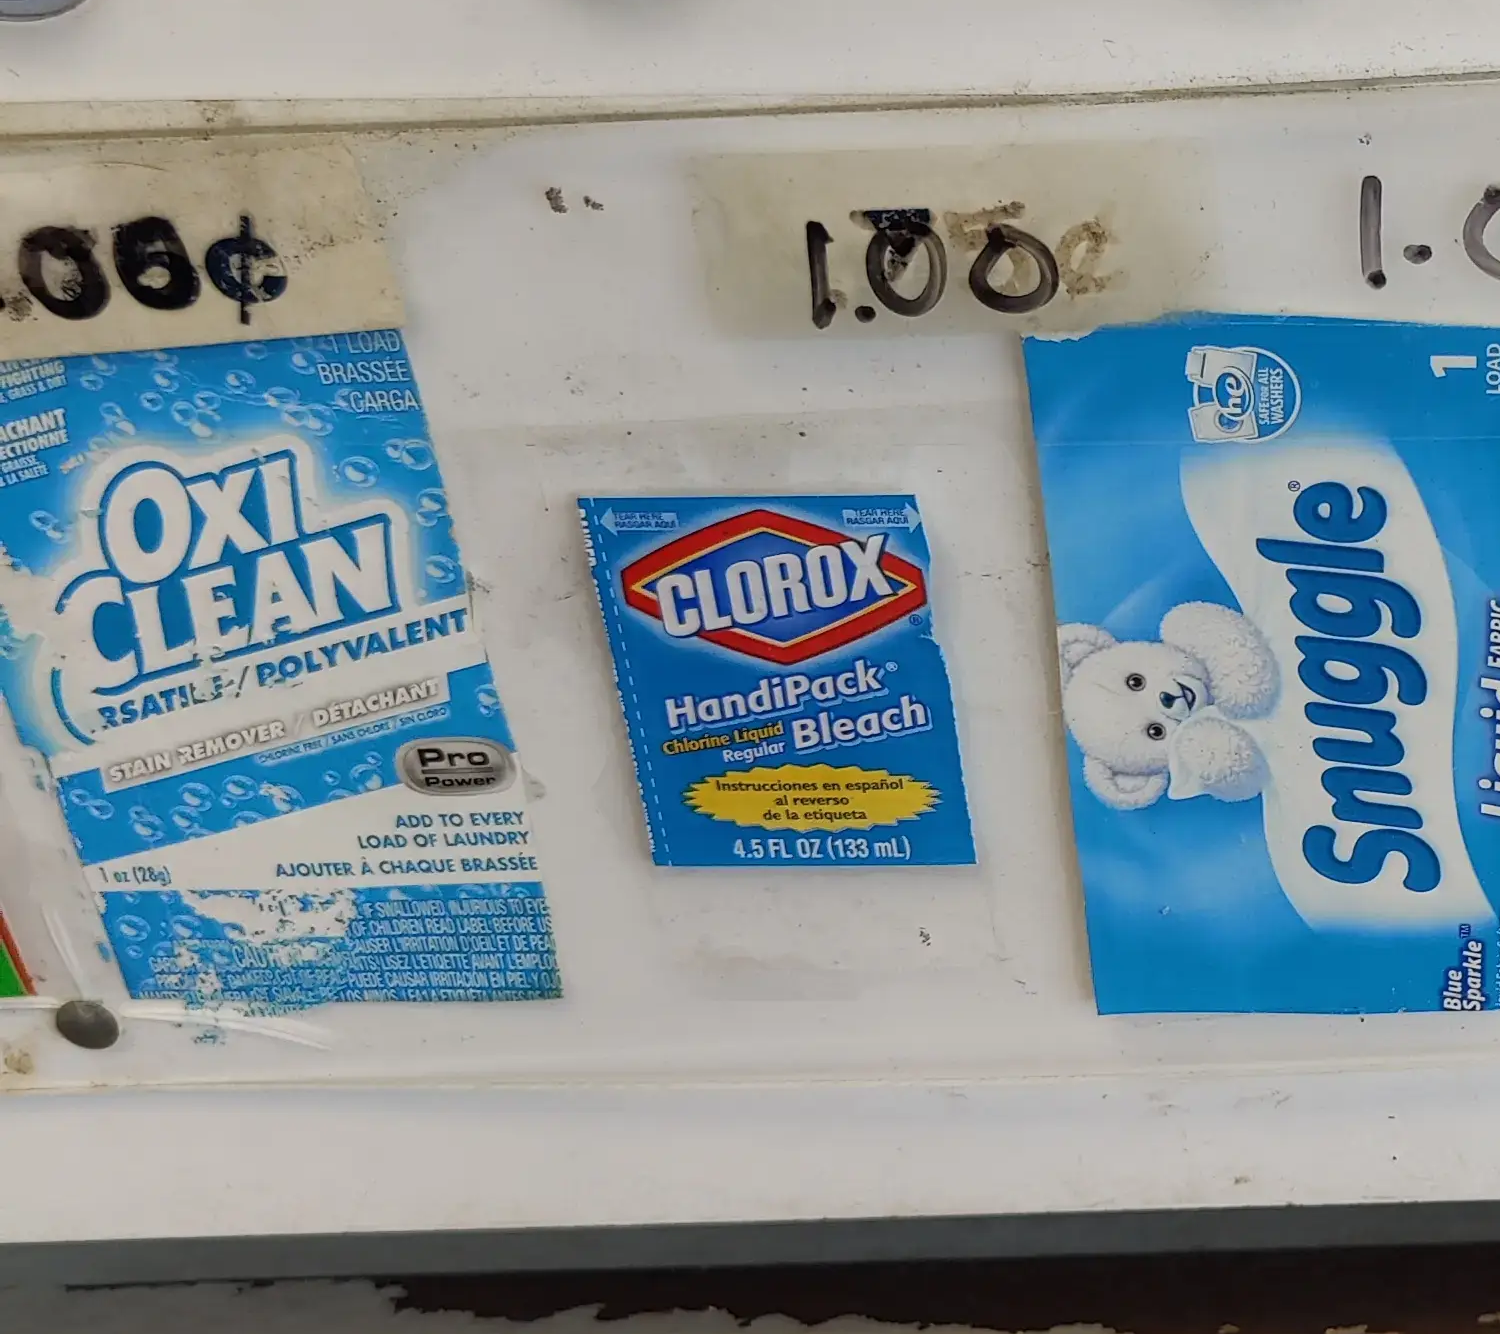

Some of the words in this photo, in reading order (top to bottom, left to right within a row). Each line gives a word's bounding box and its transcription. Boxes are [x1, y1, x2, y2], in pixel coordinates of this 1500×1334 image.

[346, 331, 401, 354] LOAD
[316, 356, 411, 385] BRASSÉE
[1258, 367, 1269, 384] ALL
[1430, 355, 1477, 377] 1
[350, 390, 420, 413] CARGA
[1261, 386, 1269, 401] FOR
[1270, 368, 1285, 424] WASHERS
[1258, 402, 1270, 425] SAFE
[101, 451, 303, 585] OXI
[656, 532, 899, 638] CLOROX
[58, 515, 400, 693] CLEAN
[257, 607, 468, 688] POLYVALENT
[109, 750, 172, 783] STAIN
[177, 720, 286, 765] REMOVER
[312, 678, 441, 728] DÉTACHANT
[662, 732, 730, 756] Chlorine
[733, 721, 784, 745] Liquid
[723, 742, 786, 764] Regular
[792, 694, 929, 752] Bleach
[417, 748, 490, 768] Pro
[424, 775, 496, 788] Power
[715, 779, 819, 793] Instrucciones
[822, 782, 841, 793] en
[845, 778, 904, 795] español
[774, 795, 788, 807] al
[793, 796, 849, 807] reverso
[396, 814, 433, 828] ADD
[438, 813, 463, 826] TO
[470, 811, 525, 826] EVERY
[763, 809, 781, 821] de
[785, 809, 800, 820] la
[803, 809, 868, 823] etiqueta
[357, 833, 408, 849] LOAD
[413, 833, 437, 847] OF
[444, 831, 529, 847] LAUNDRY
[733, 838, 764, 859] 4.5
[769, 838, 792, 859] FL
[796, 838, 822, 859] OZ
[827, 837, 870, 862] (133
[875, 835, 913, 861] mL)
[99, 867, 108, 883] 1
[276, 862, 355, 877] AJOUTER
[379, 857, 456, 874] CHAQUE
[461, 853, 538, 871] BRASSÉE
[1443, 970, 1462, 1010] Blue
